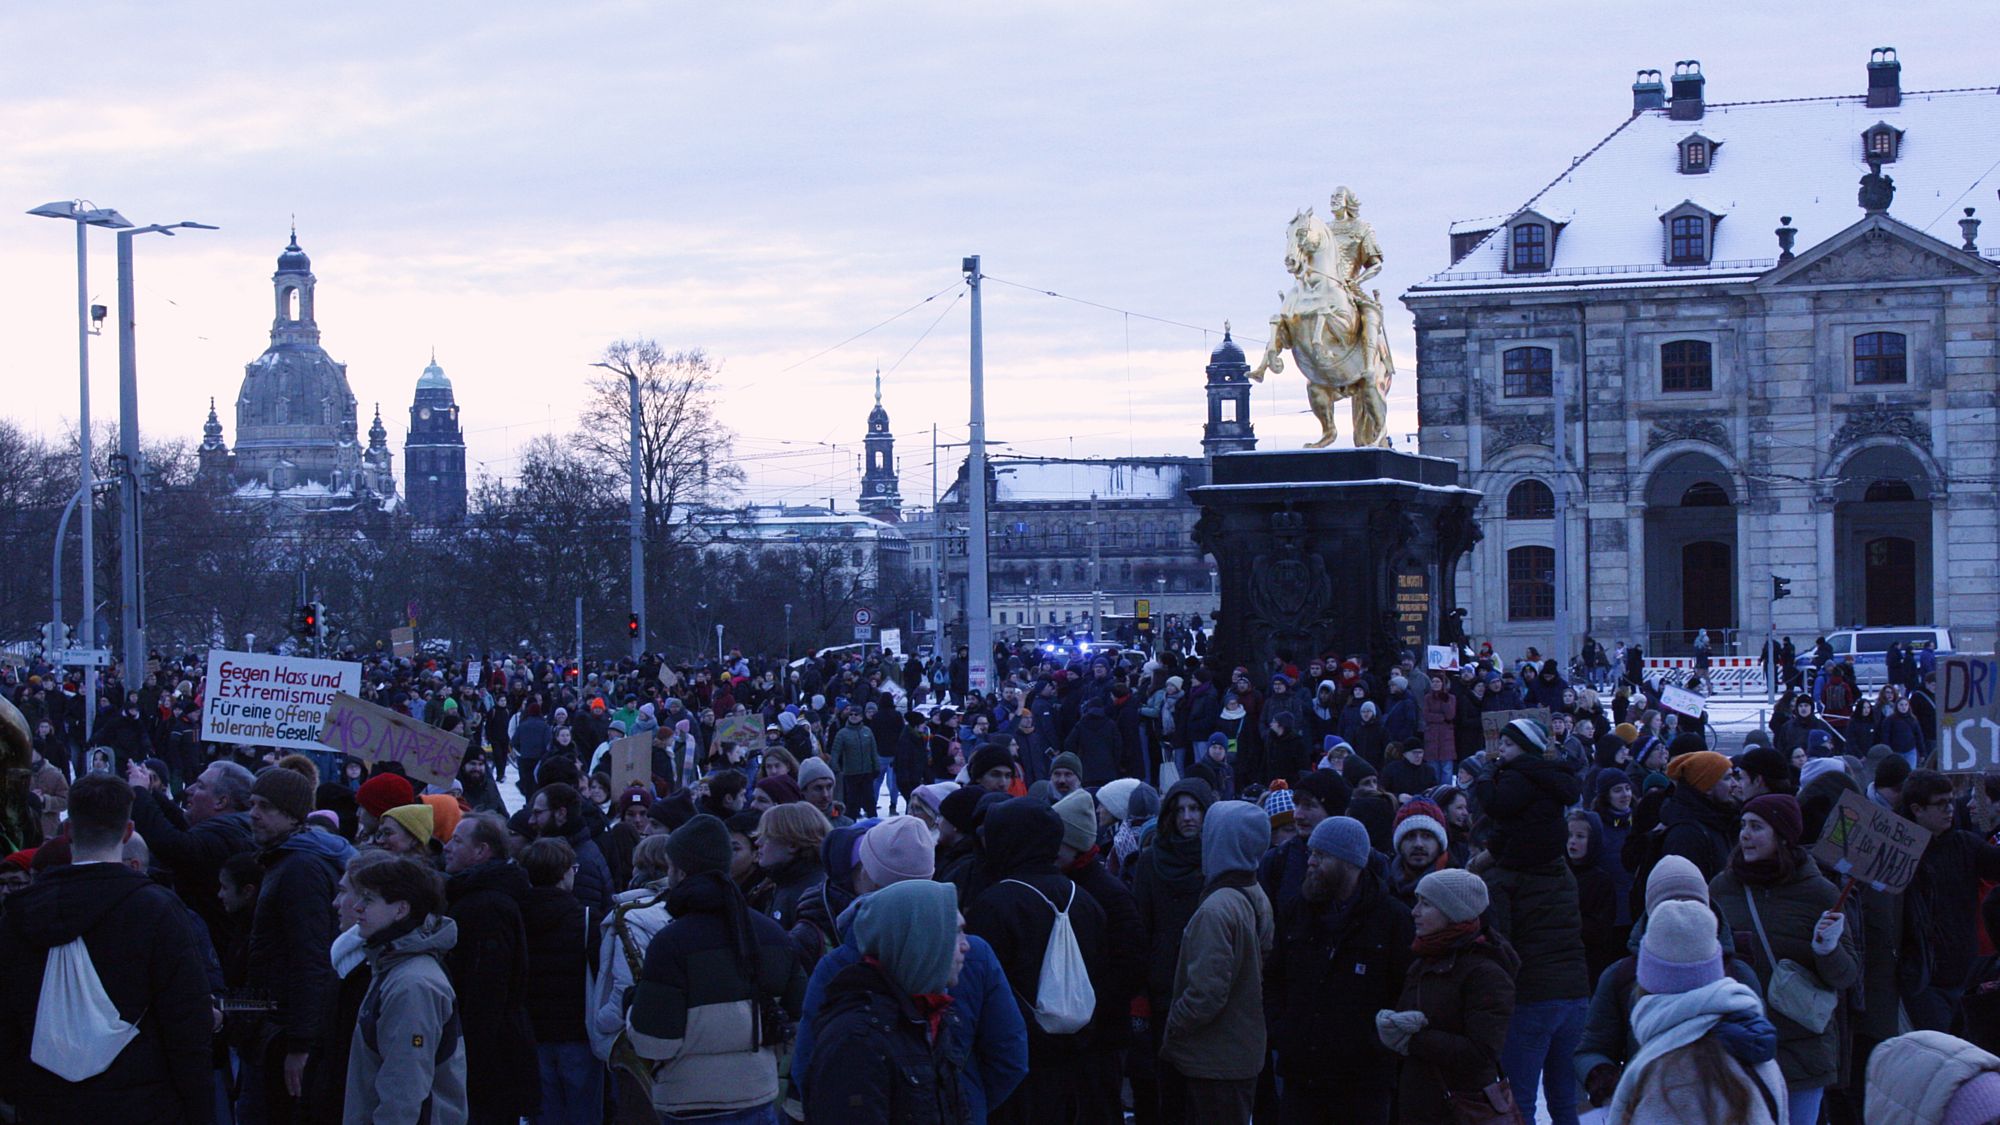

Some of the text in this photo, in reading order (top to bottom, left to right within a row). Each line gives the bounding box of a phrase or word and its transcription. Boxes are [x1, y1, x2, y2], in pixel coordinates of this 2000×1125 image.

[219, 661, 342, 688] Gegen Hass und
[219, 679, 347, 706] Extremismus
[210, 697, 241, 717] Für
[242, 703, 272, 719] eine
[274, 705, 322, 724] offene
[210, 716, 321, 741] tolerante Gesells
[322, 706, 463, 778] NO NAZIS
[1869, 809, 1917, 848] Kein Bier
[1855, 834, 1919, 888] für NAZIS
